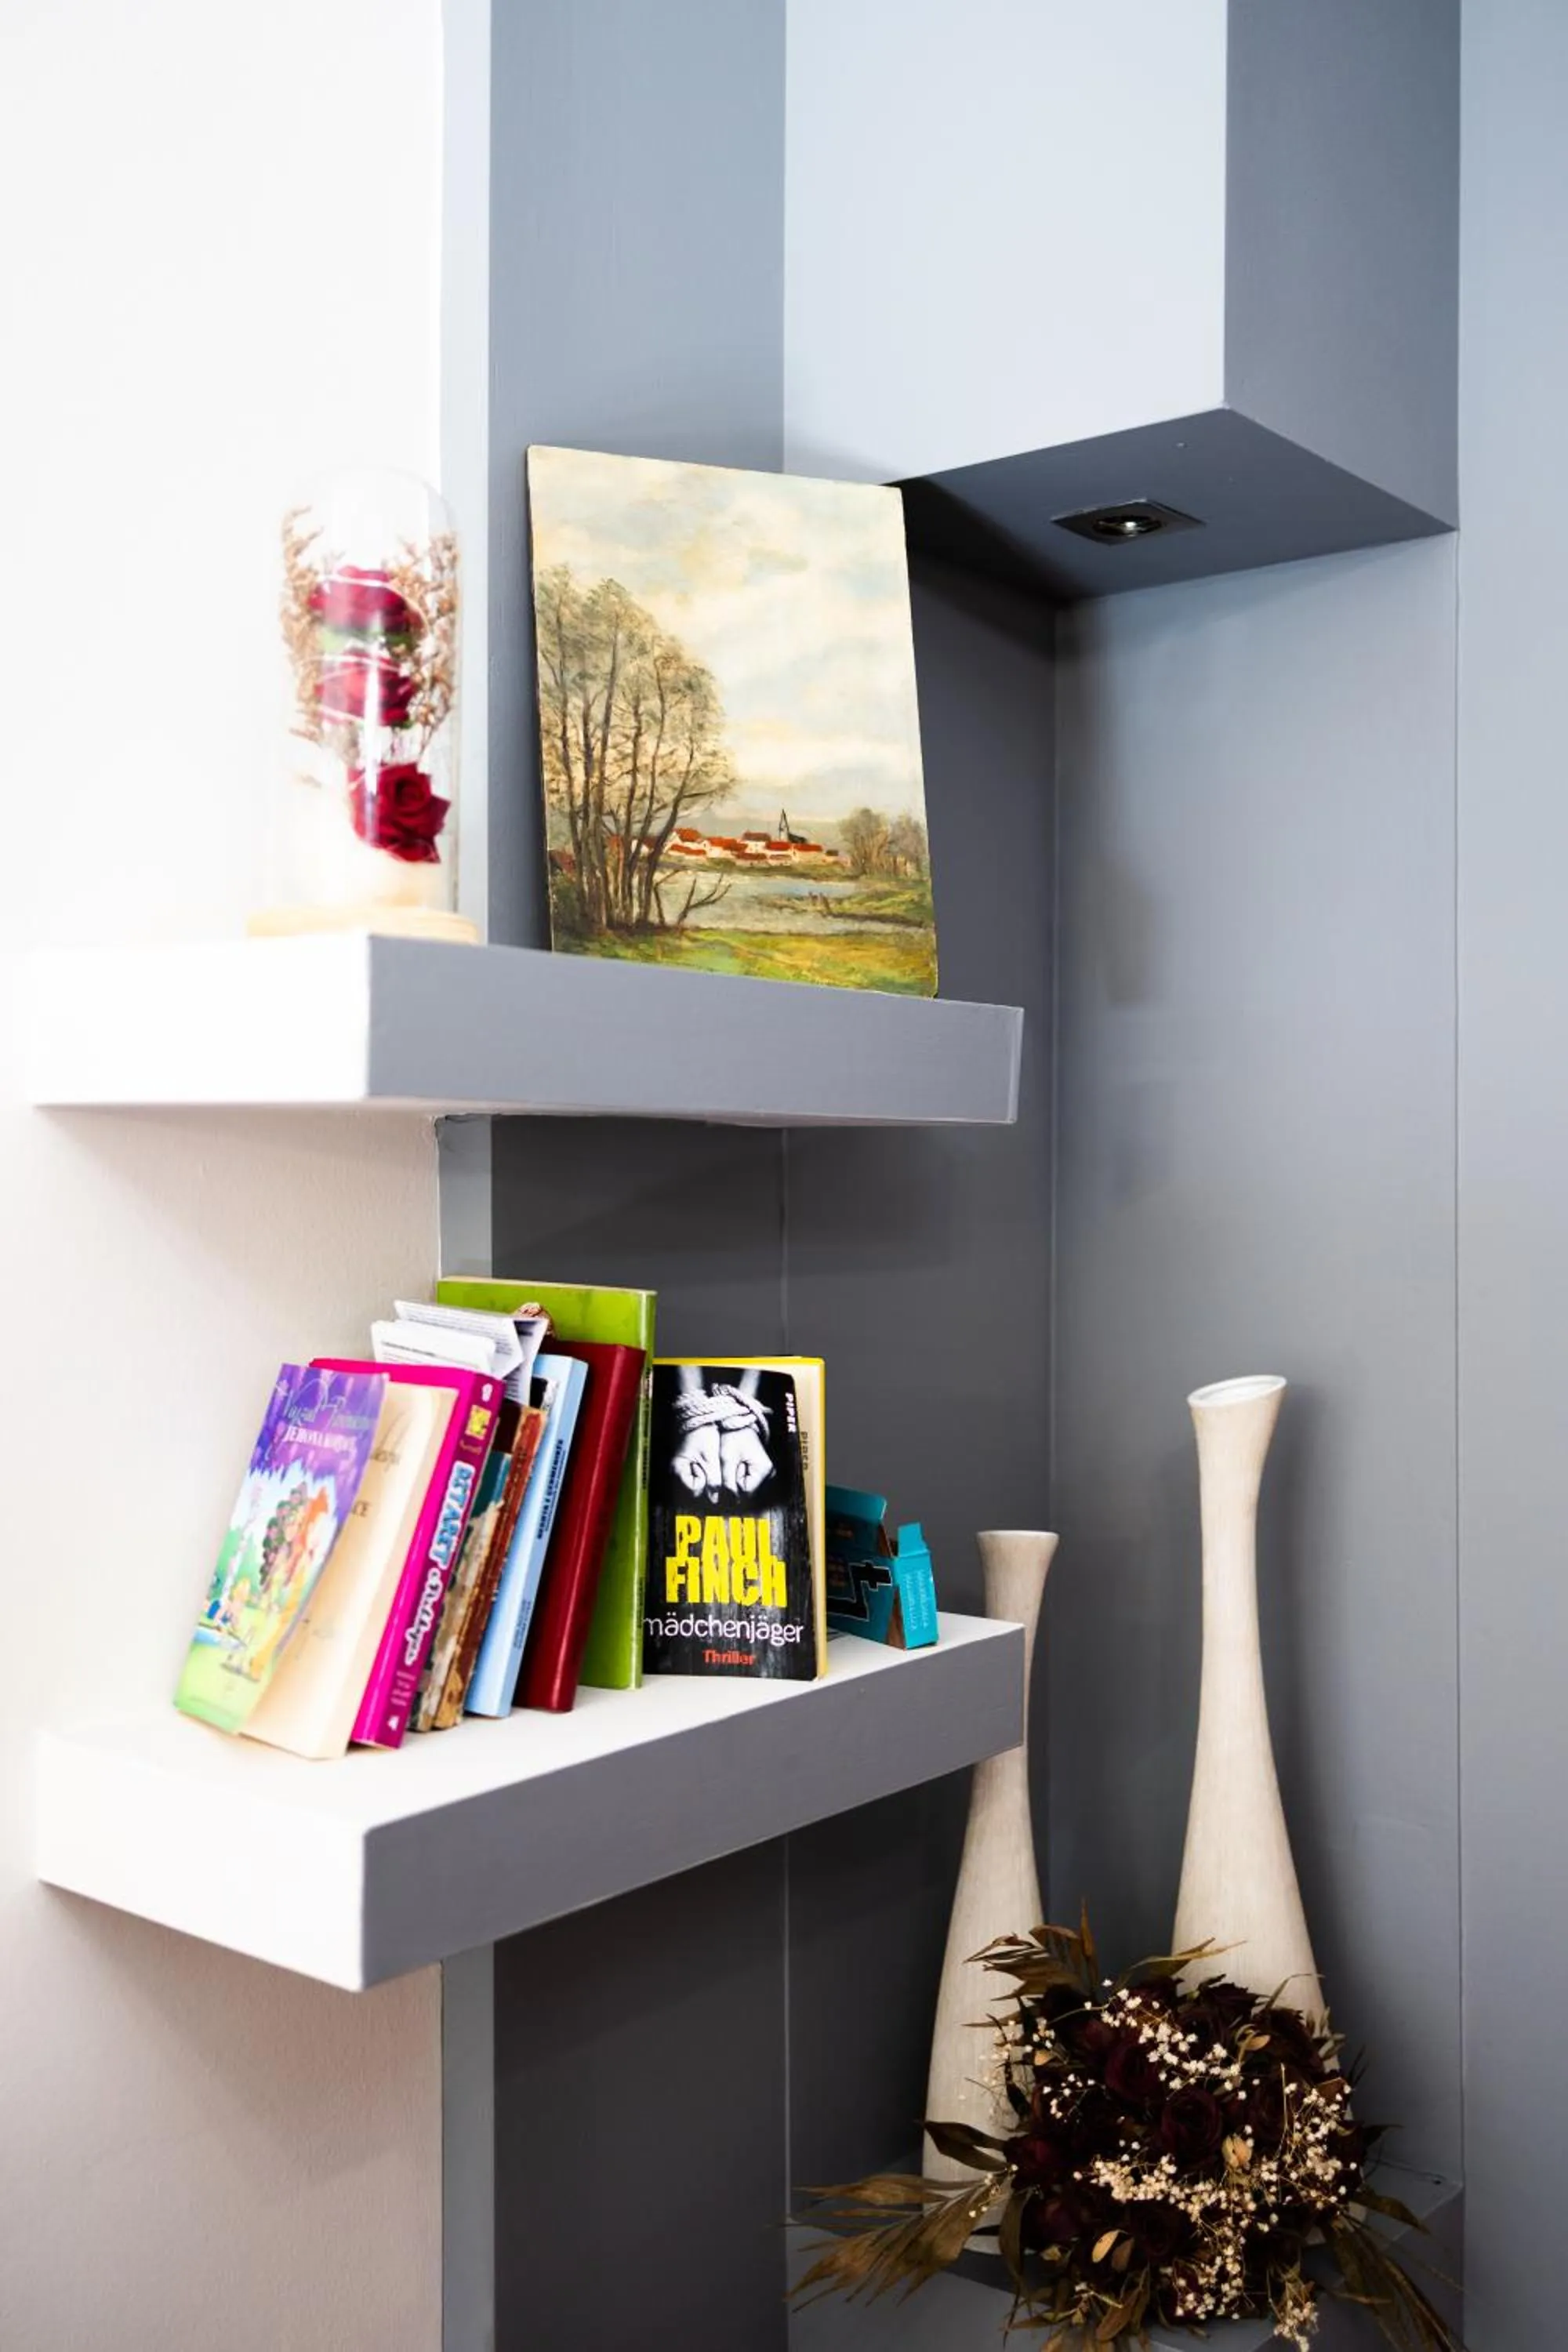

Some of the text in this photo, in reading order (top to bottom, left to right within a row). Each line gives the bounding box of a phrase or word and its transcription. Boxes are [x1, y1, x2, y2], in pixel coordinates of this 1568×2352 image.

[785, 1392, 797, 1433] PIPER
[675, 1515, 778, 1562] PAUL
[666, 1556, 787, 1608] FINCH
[642, 1612, 804, 1646] mädchenjäger
[702, 1650, 755, 1665] Thriller
